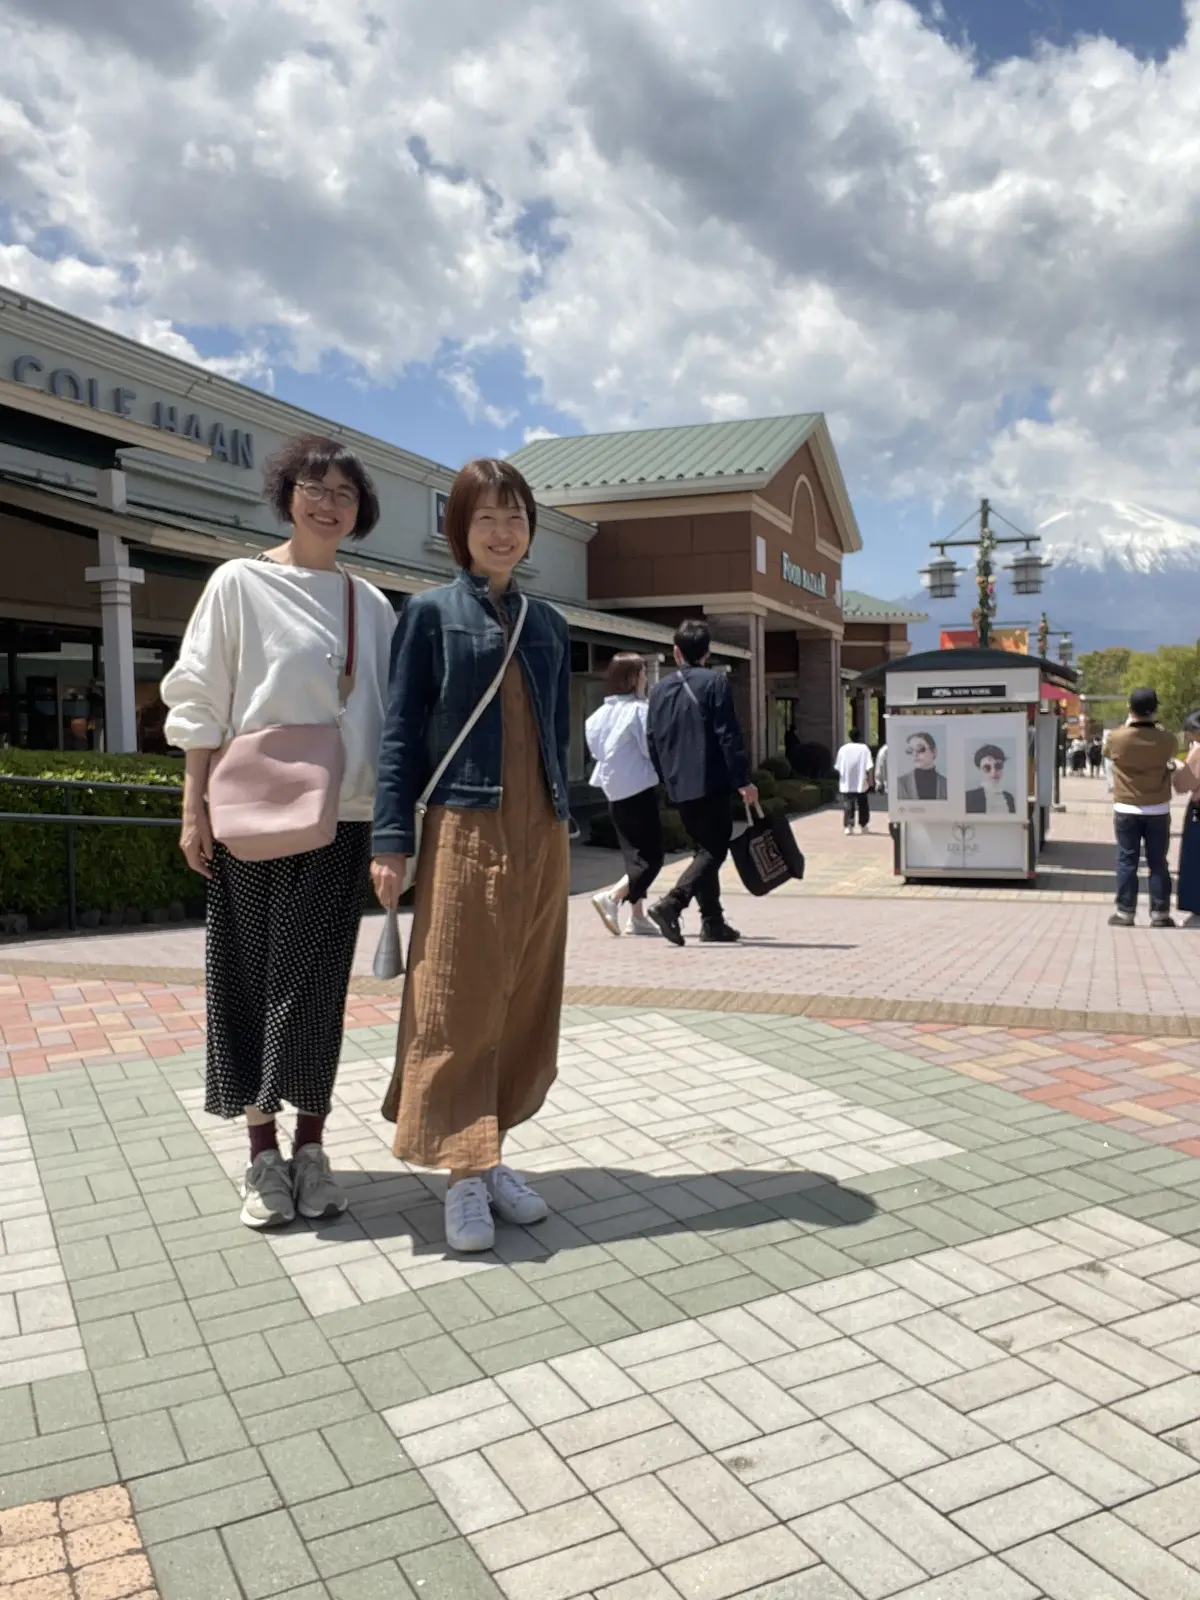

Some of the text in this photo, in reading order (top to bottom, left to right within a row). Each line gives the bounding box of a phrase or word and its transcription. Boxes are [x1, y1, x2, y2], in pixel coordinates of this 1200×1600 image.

[153, 401, 254, 469] HAAN
[952, 688, 970, 696] NEW
[970, 687, 991, 696] YORK
